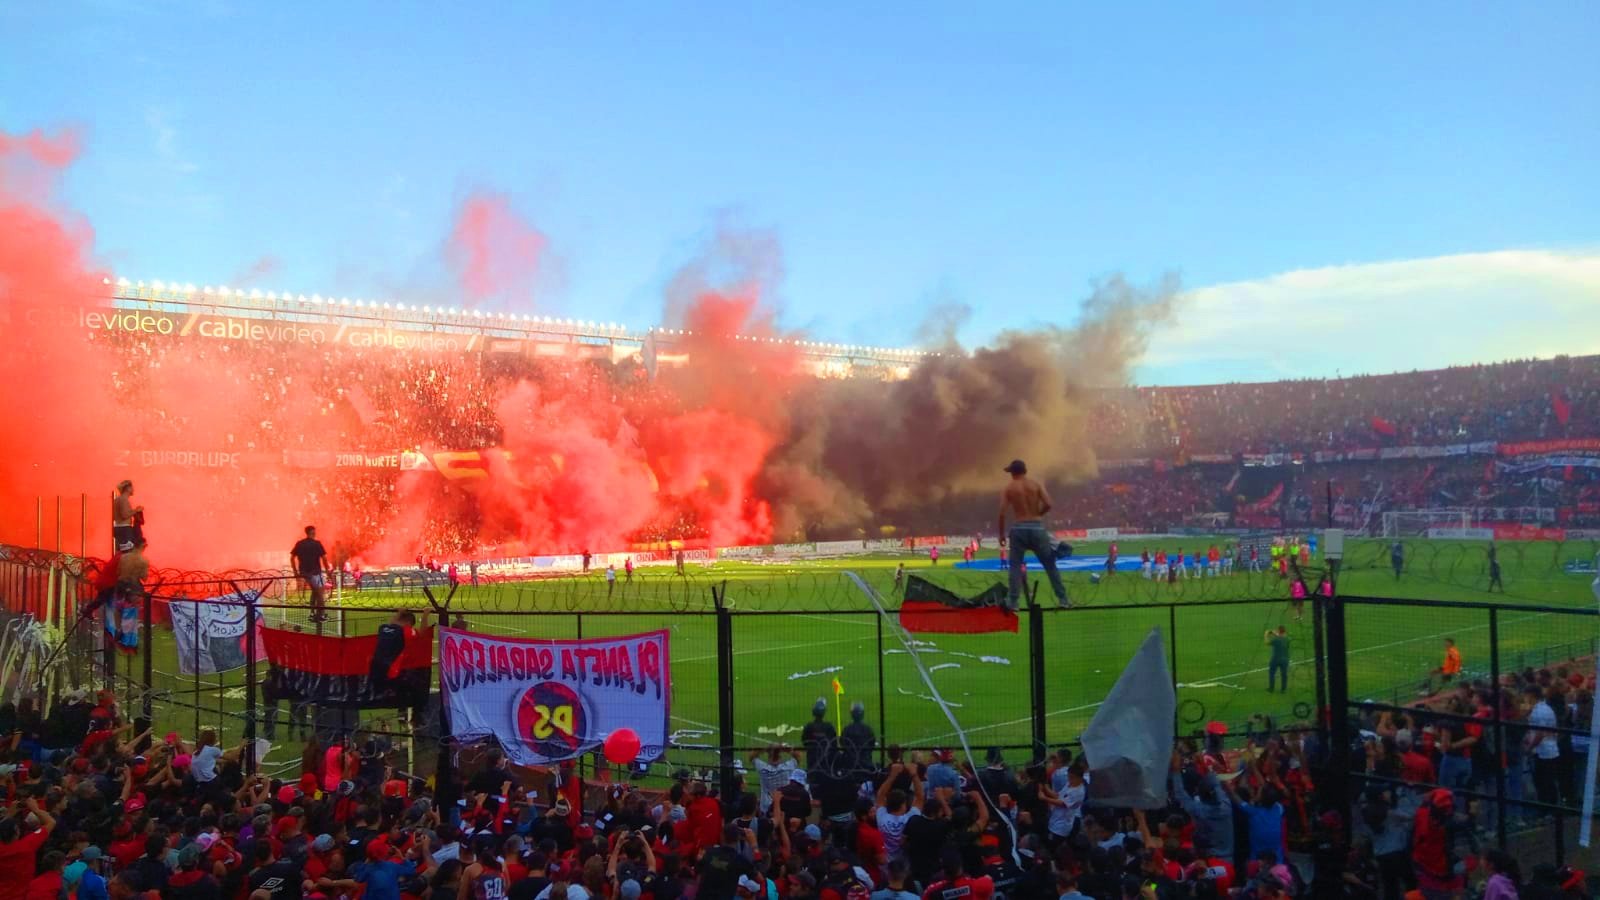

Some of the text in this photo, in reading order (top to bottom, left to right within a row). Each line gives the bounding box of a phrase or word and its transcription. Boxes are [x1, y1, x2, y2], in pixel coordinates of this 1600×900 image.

[199, 317, 326, 344] cablevideo
[348, 327, 459, 352] cablevideo
[141, 450, 240, 470] GUADALUPE
[336, 454, 398, 468] ZONA NORTE
